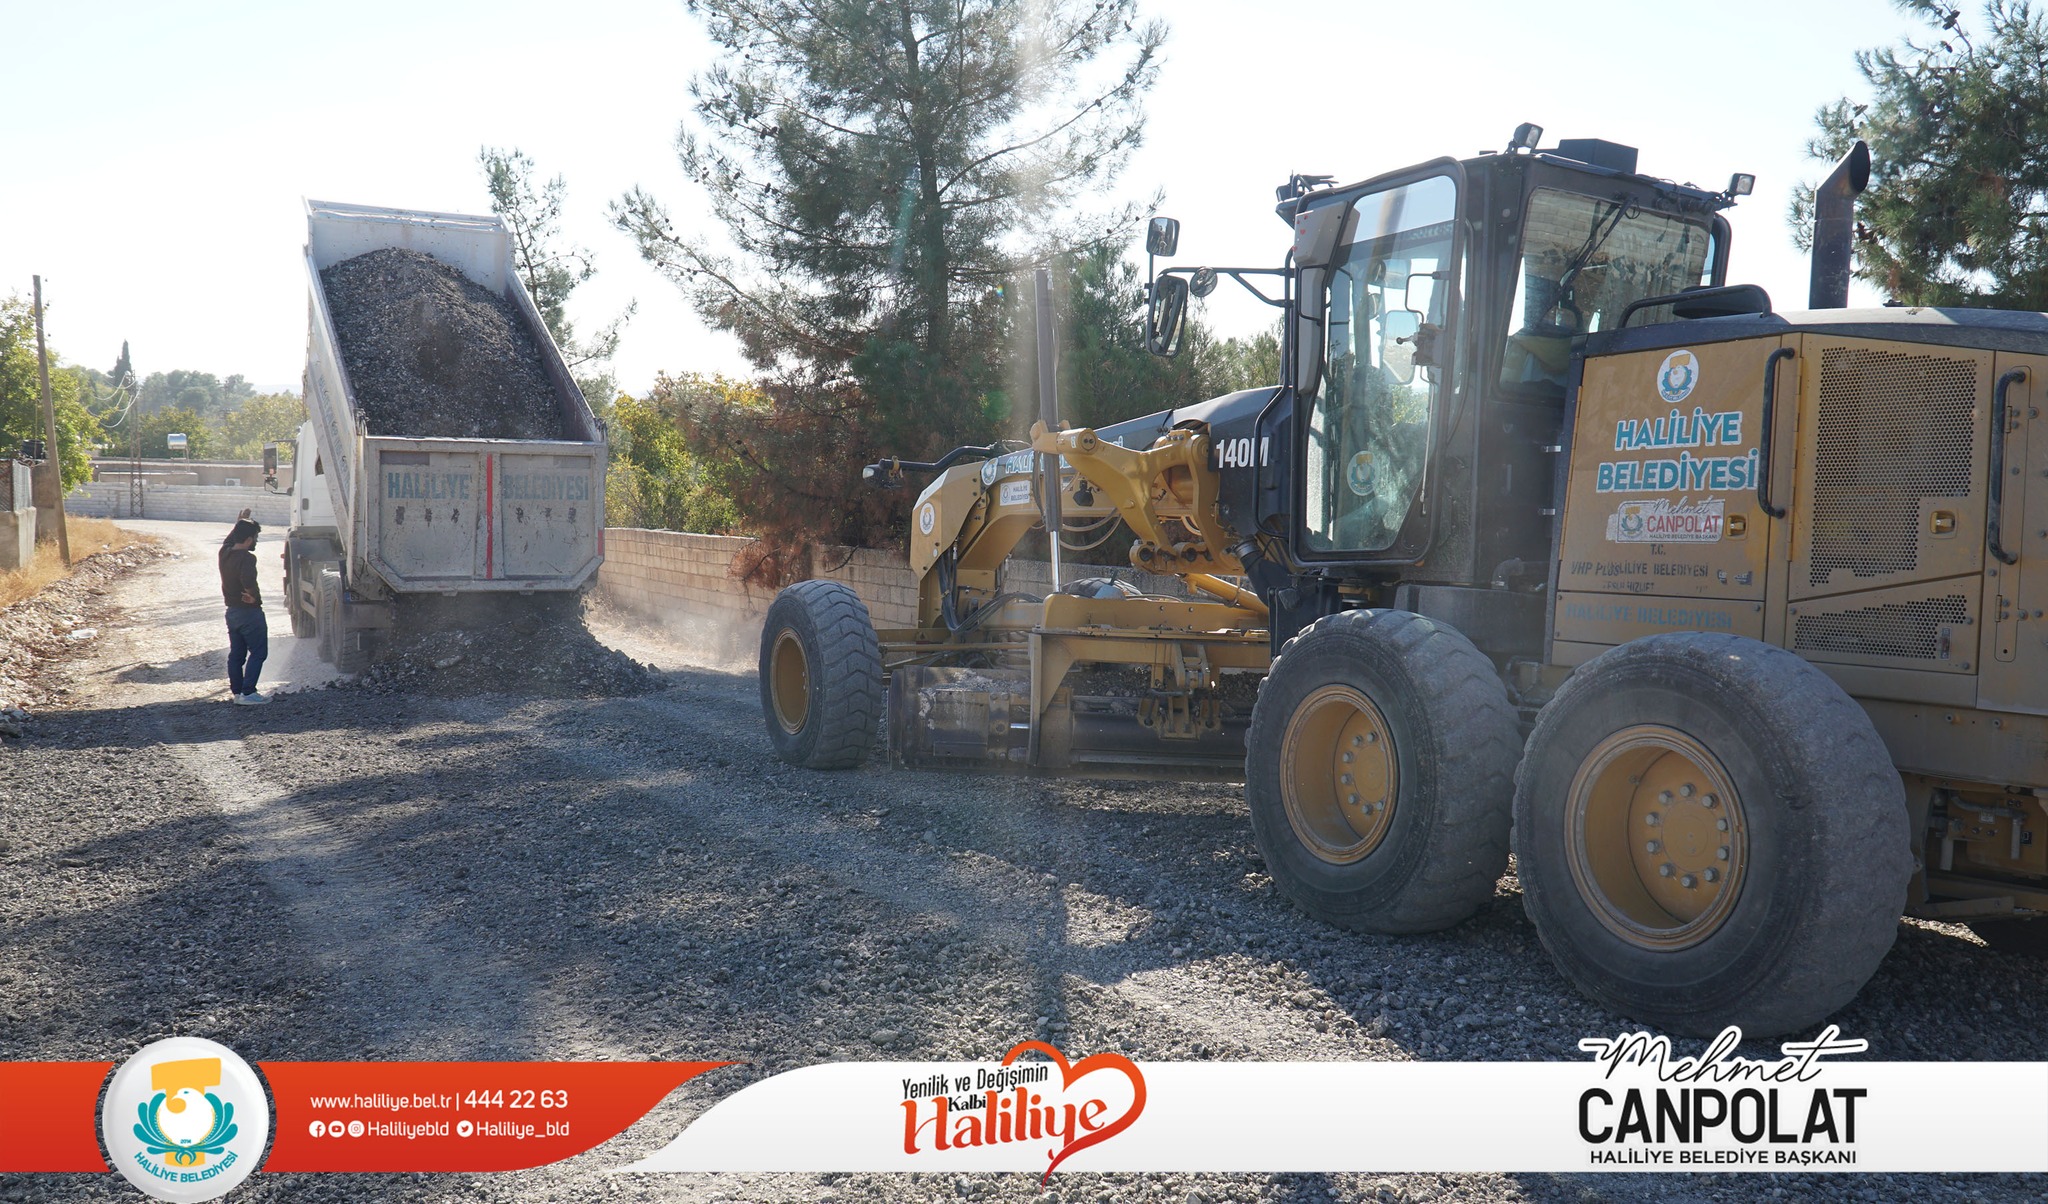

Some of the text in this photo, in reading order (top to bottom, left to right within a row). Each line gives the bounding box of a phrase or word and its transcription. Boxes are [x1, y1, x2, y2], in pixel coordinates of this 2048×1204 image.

[1615, 407, 1742, 451] HALİLİYE
[1216, 436, 1269, 468] 140M
[1597, 448, 1759, 492] BELEDİYESİ
[387, 472, 469, 499] HALİLİYE
[1653, 495, 1714, 514] Mehmet
[1647, 515, 1720, 533] CANPOLAT
